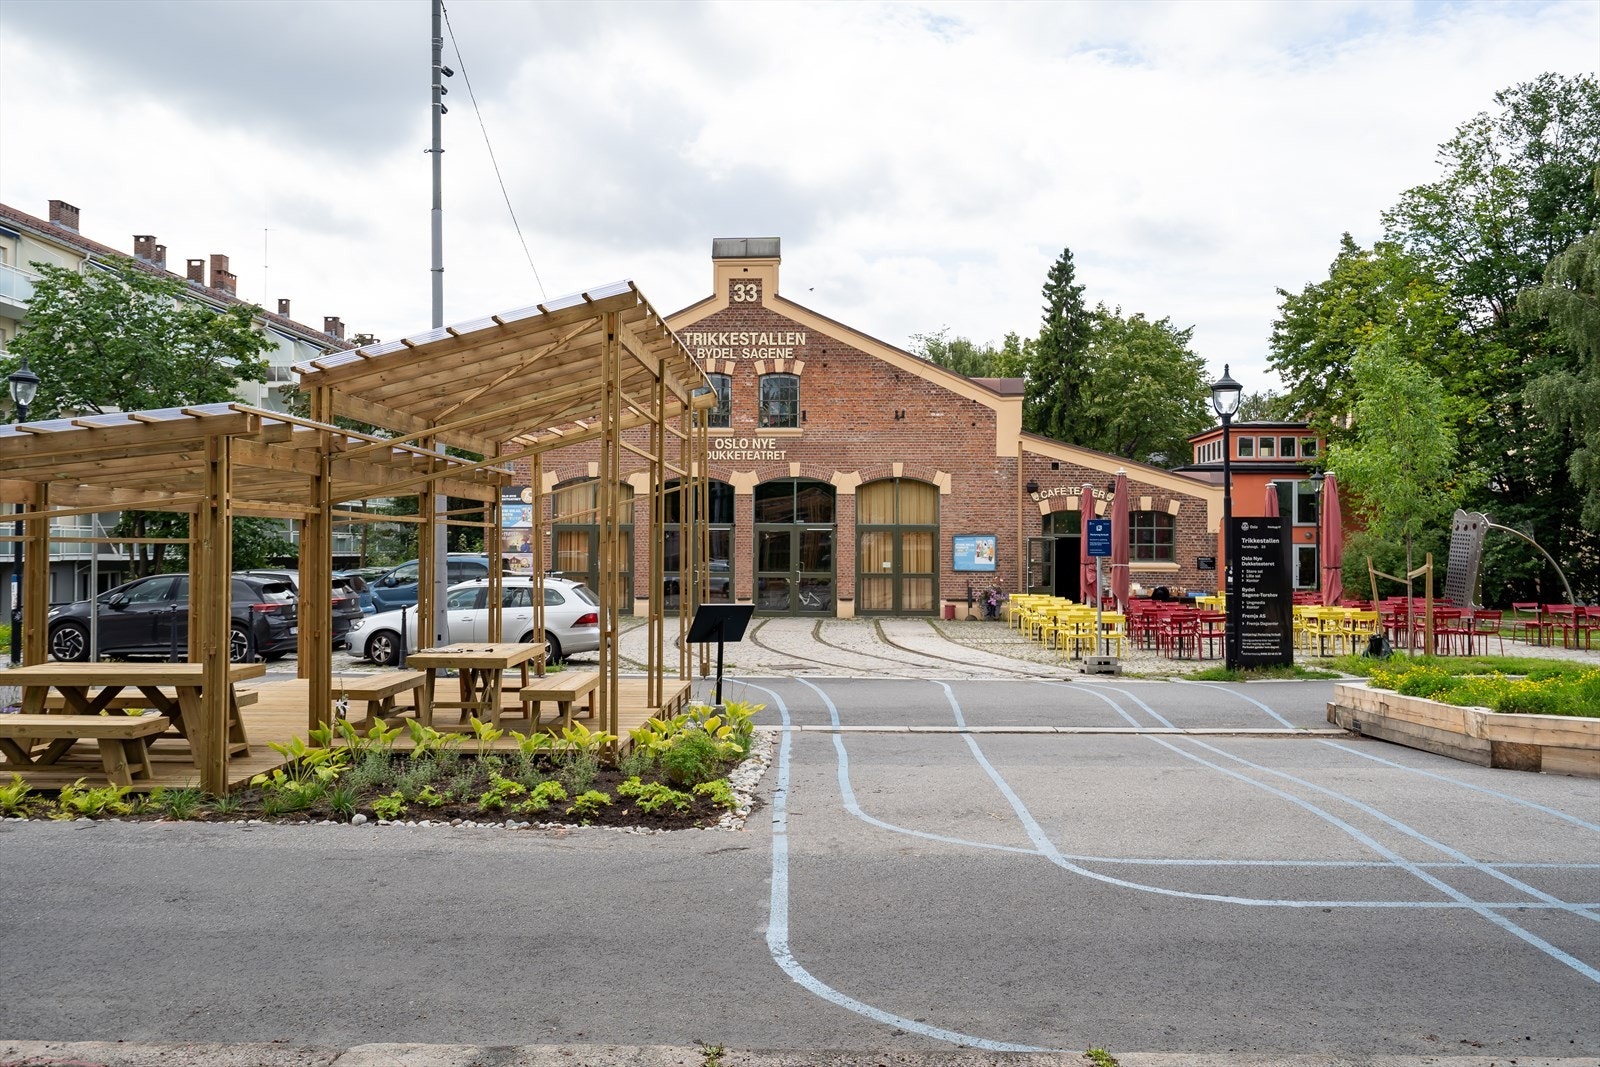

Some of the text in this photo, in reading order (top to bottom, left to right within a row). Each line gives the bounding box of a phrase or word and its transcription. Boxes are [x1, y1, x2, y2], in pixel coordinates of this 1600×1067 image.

[733, 283, 758, 303] 33
[683, 332, 806, 346] TRIKKESTALLEN
[696, 347, 794, 359] BYDEL SAGENE
[714, 438, 776, 450] OSLO NYE
[1040, 485, 1105, 499] CAFÉ TEER
